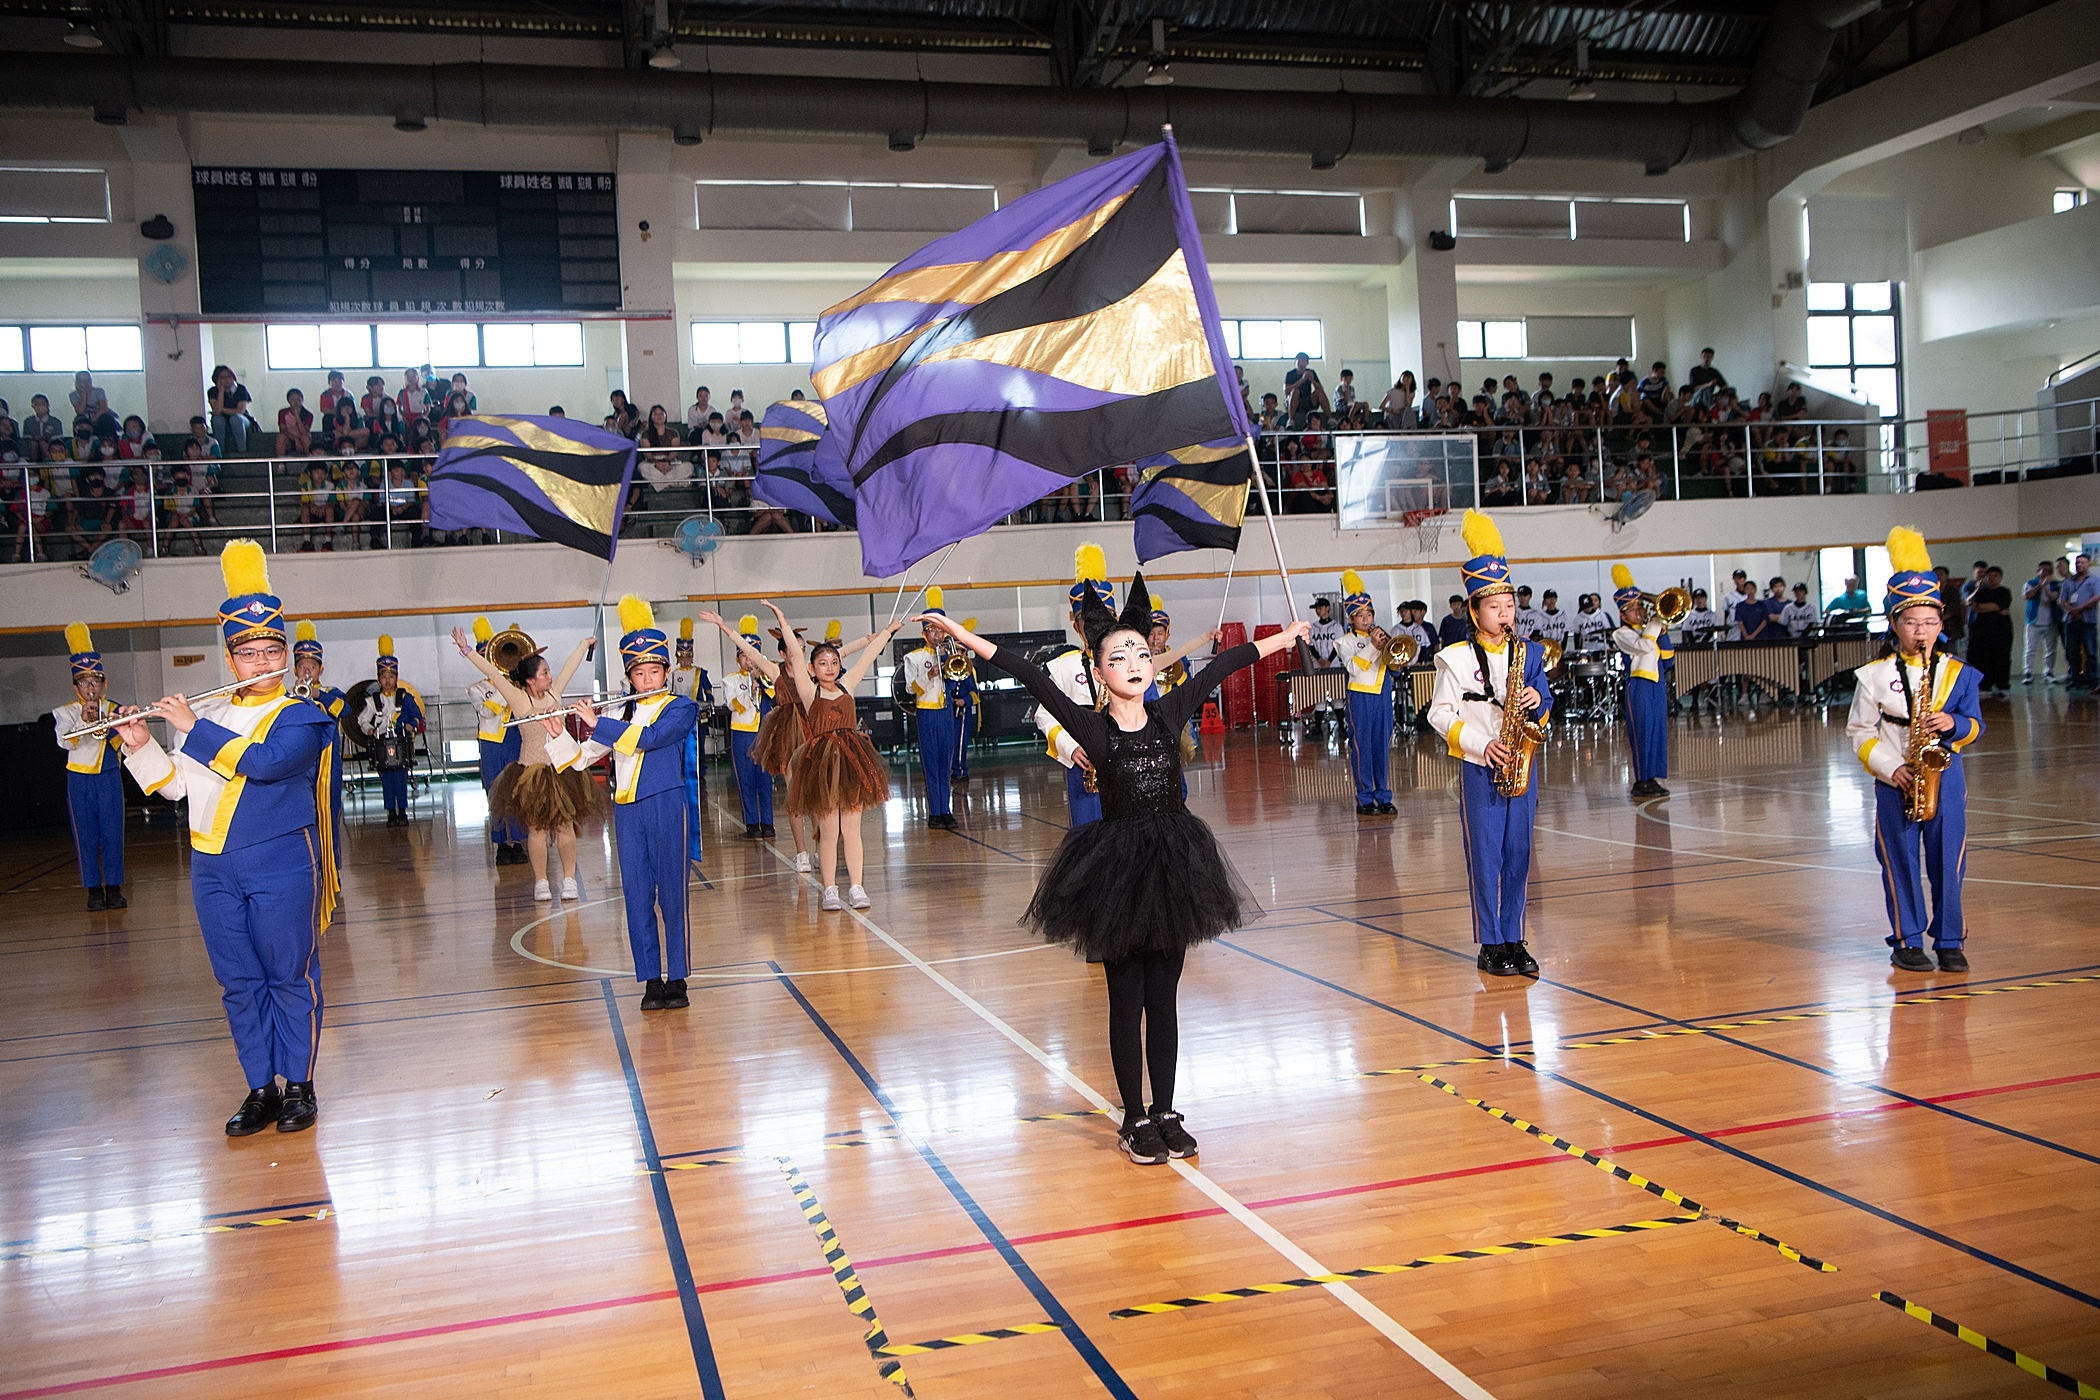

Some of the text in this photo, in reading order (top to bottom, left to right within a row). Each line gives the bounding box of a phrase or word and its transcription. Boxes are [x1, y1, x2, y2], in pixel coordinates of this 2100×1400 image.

[195, 170, 253, 186] 球員姓名
[500, 175, 553, 190] 球員姓名
[1516, 618, 1535, 627] ANO
[1205, 709, 1217, 718] 35
